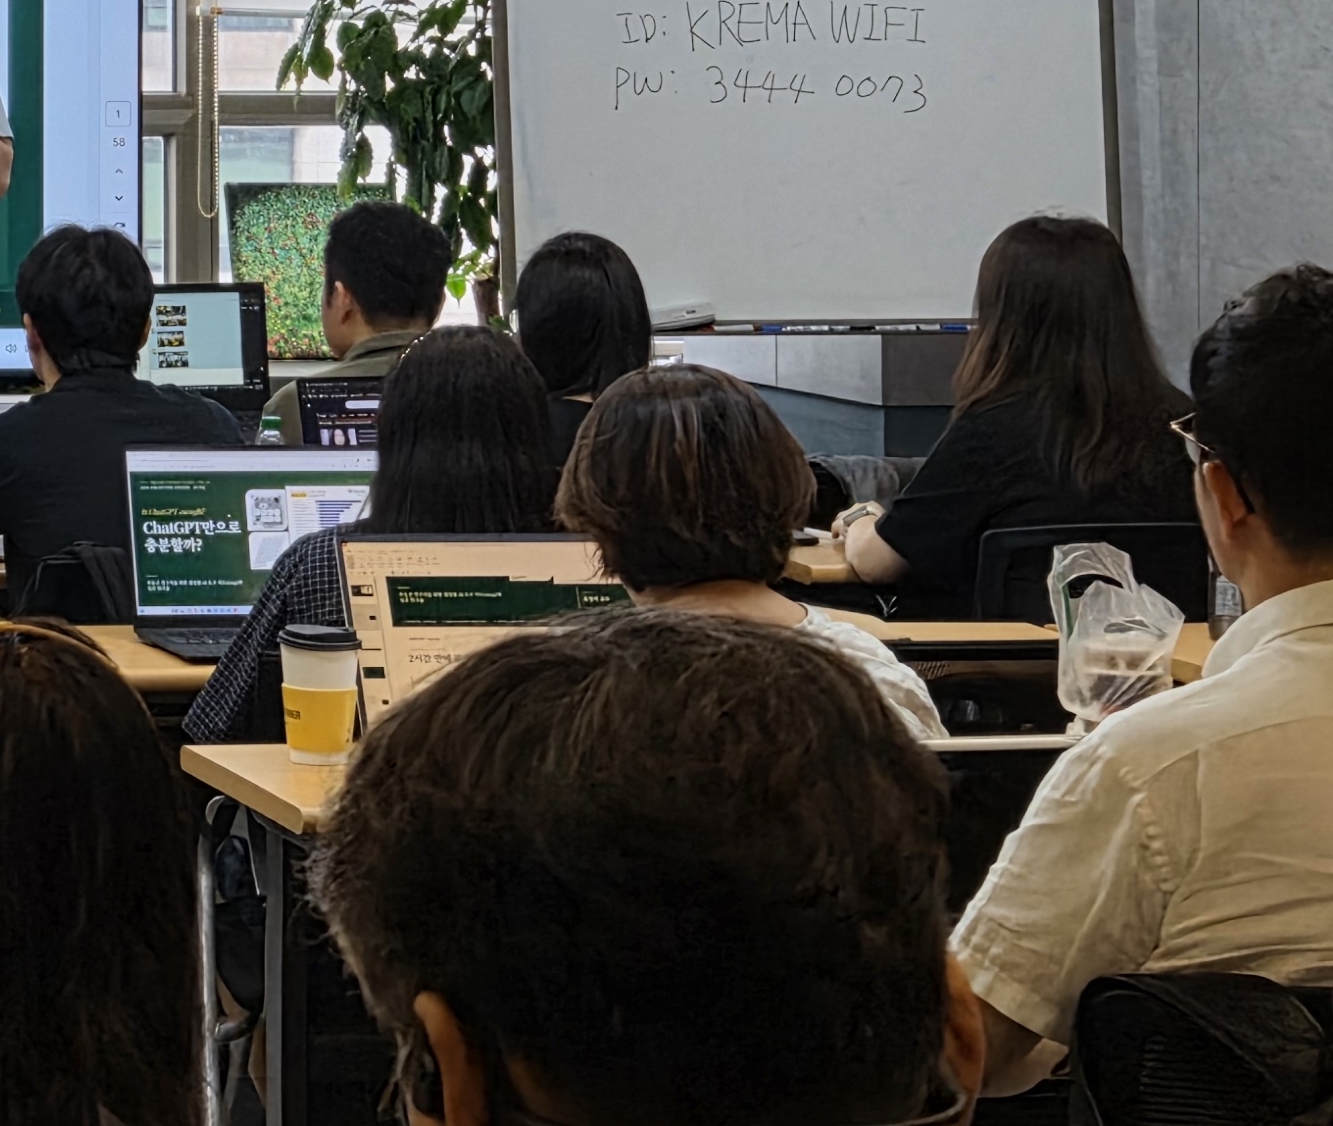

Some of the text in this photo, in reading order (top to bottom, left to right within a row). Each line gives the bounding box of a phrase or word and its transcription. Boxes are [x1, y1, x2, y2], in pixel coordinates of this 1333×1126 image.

[616, 0, 927, 52] ID: KREMA WIFI
[706, 66, 815, 104] 3444
[835, 74, 927, 113] 0073
[112, 136, 126, 147] 58
[143, 520, 242, 535] ChatGPT만으로
[144, 537, 202, 553] 충분할까?
